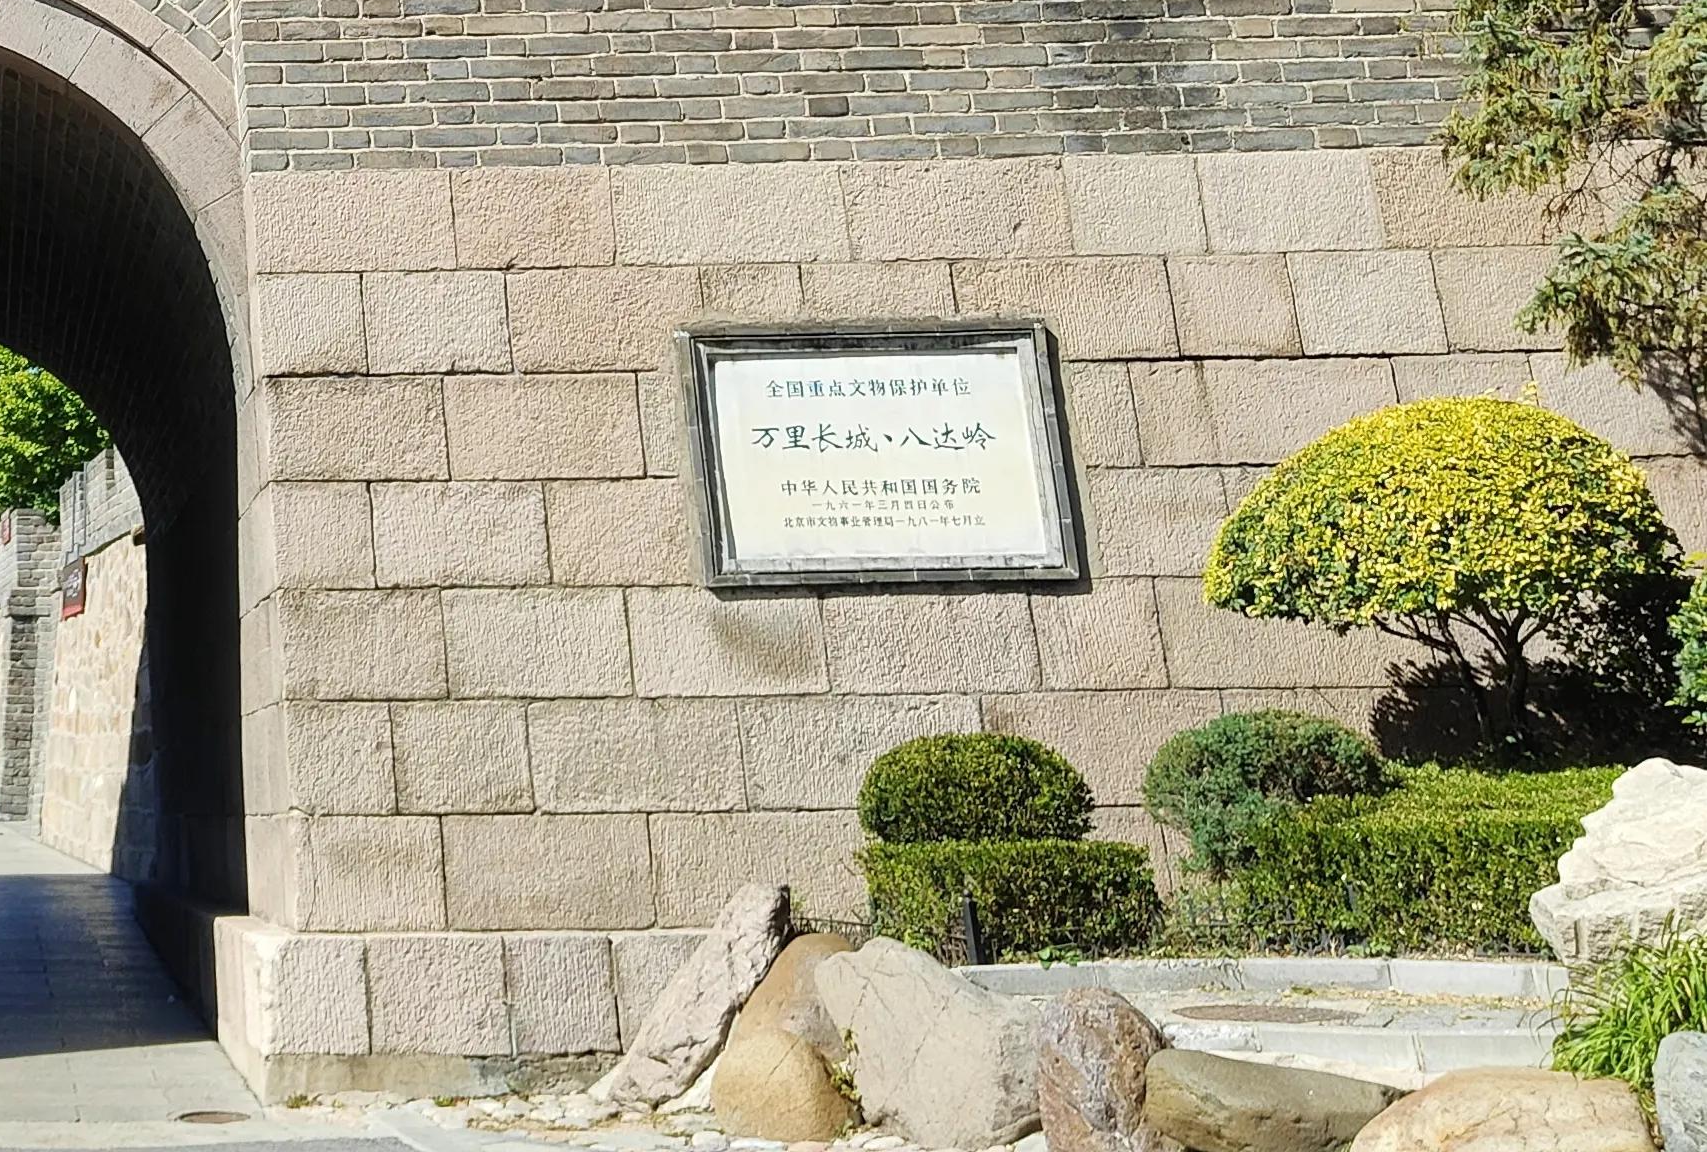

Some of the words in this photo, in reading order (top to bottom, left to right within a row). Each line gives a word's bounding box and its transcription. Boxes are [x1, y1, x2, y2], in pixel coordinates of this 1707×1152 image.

[766, 377, 971, 398] 全国重点文物保护单位
[781, 477, 981, 496] 中华人民共和国国务院
[812, 499, 954, 510] 一九六一年三月四日公布
[783, 515, 985, 528] 北京市文物事业管理局一九八一年七月立
